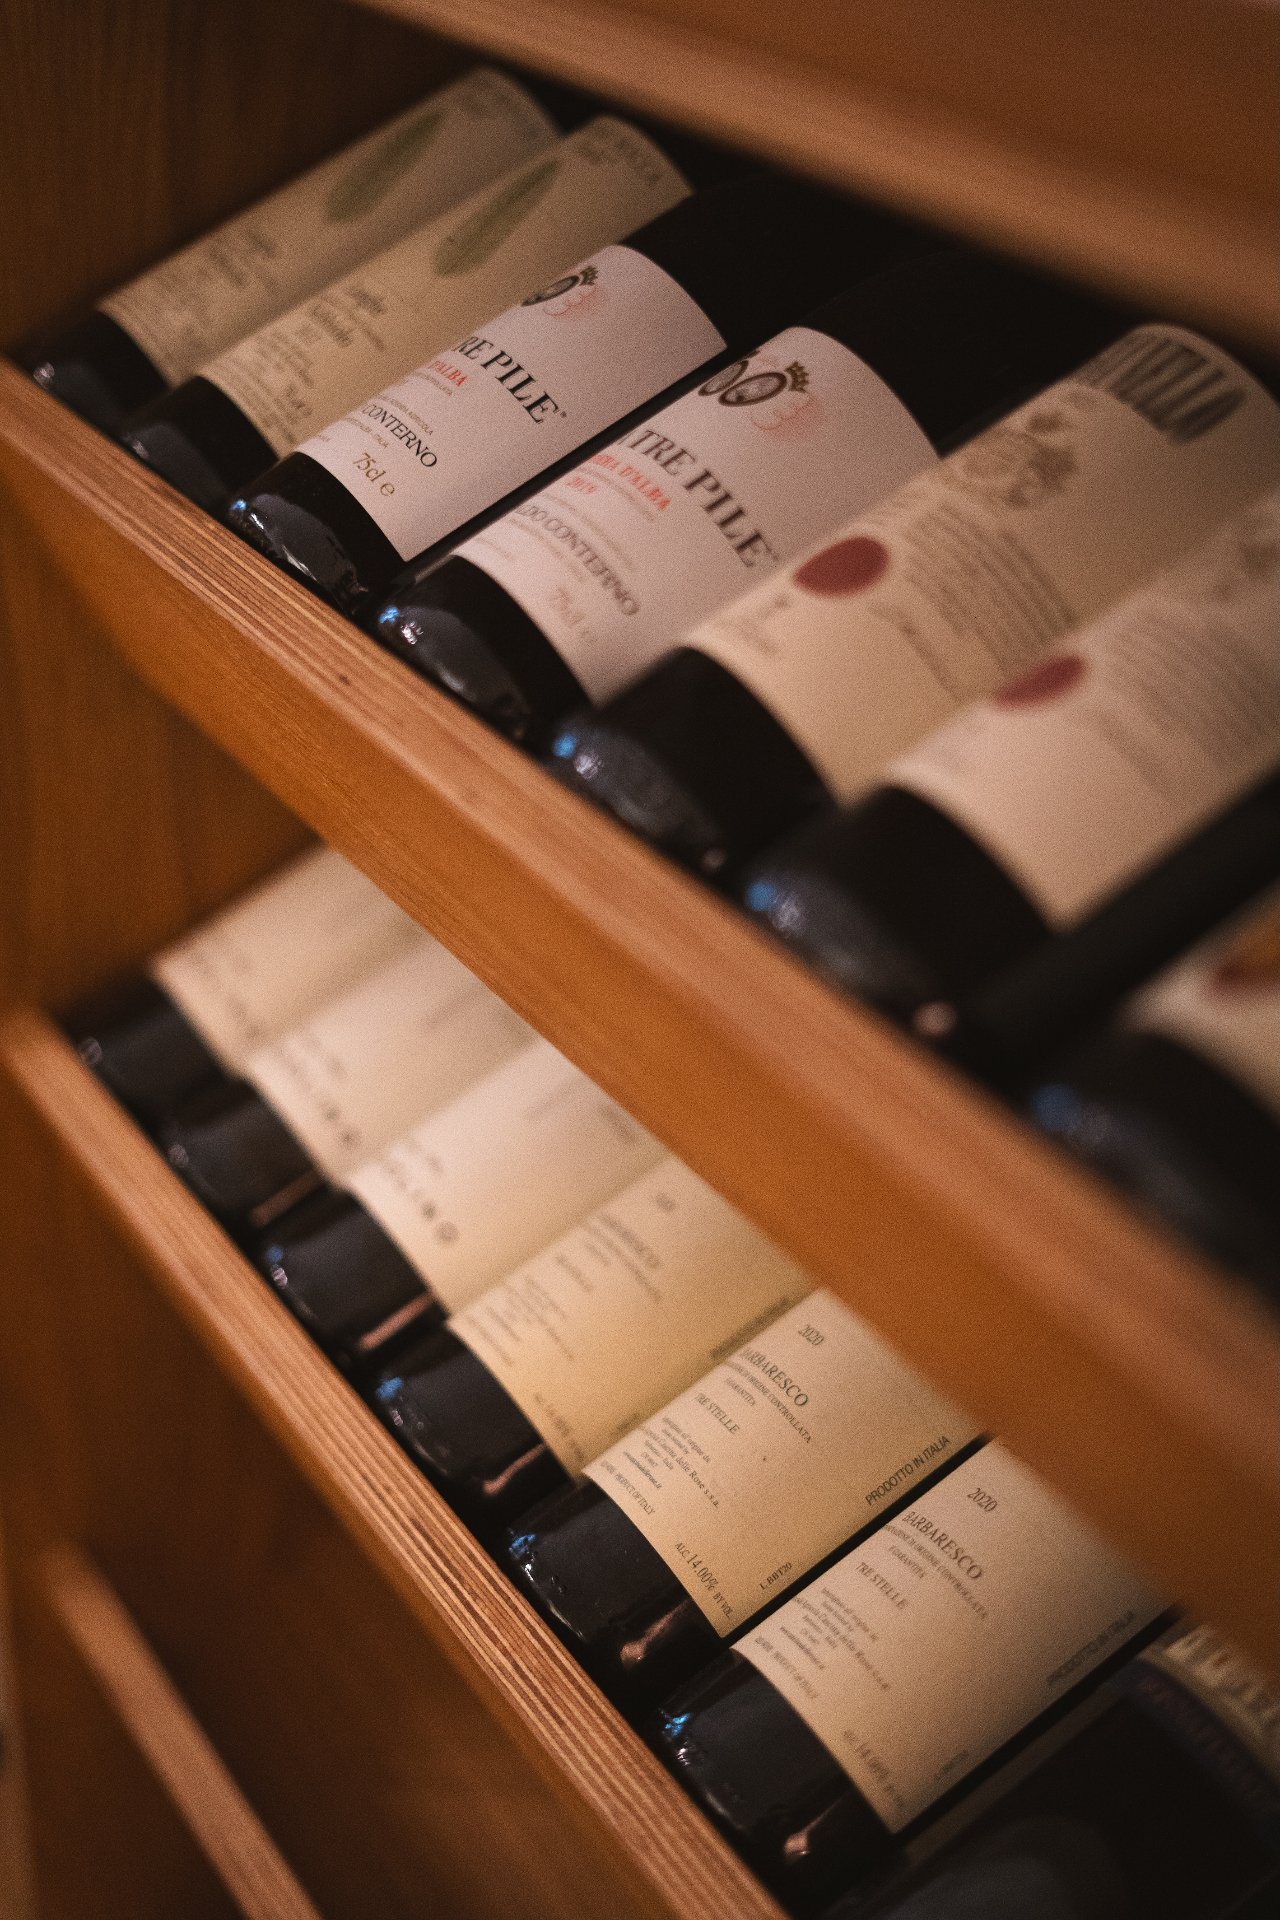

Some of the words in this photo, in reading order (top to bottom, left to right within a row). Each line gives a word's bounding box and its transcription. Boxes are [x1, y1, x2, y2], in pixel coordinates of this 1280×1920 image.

[453, 336, 494, 360] RE
[361, 404, 438, 468] CONTERNO
[352, 452, 387, 483] 75cl
[627, 429, 697, 477] TRE
[543, 517, 641, 617] CONTERNO
[797, 1323, 825, 1347] 2020
[706, 1400, 741, 1435] STELLE
[688, 1469, 706, 1490] Rose
[864, 1461, 915, 1507] PRODOTTO
[919, 1435, 951, 1465] ITALIA
[967, 1487, 998, 1513] 2020
[901, 1510, 984, 1581] BARBARESCO
[855, 1561, 872, 1578] TRE
